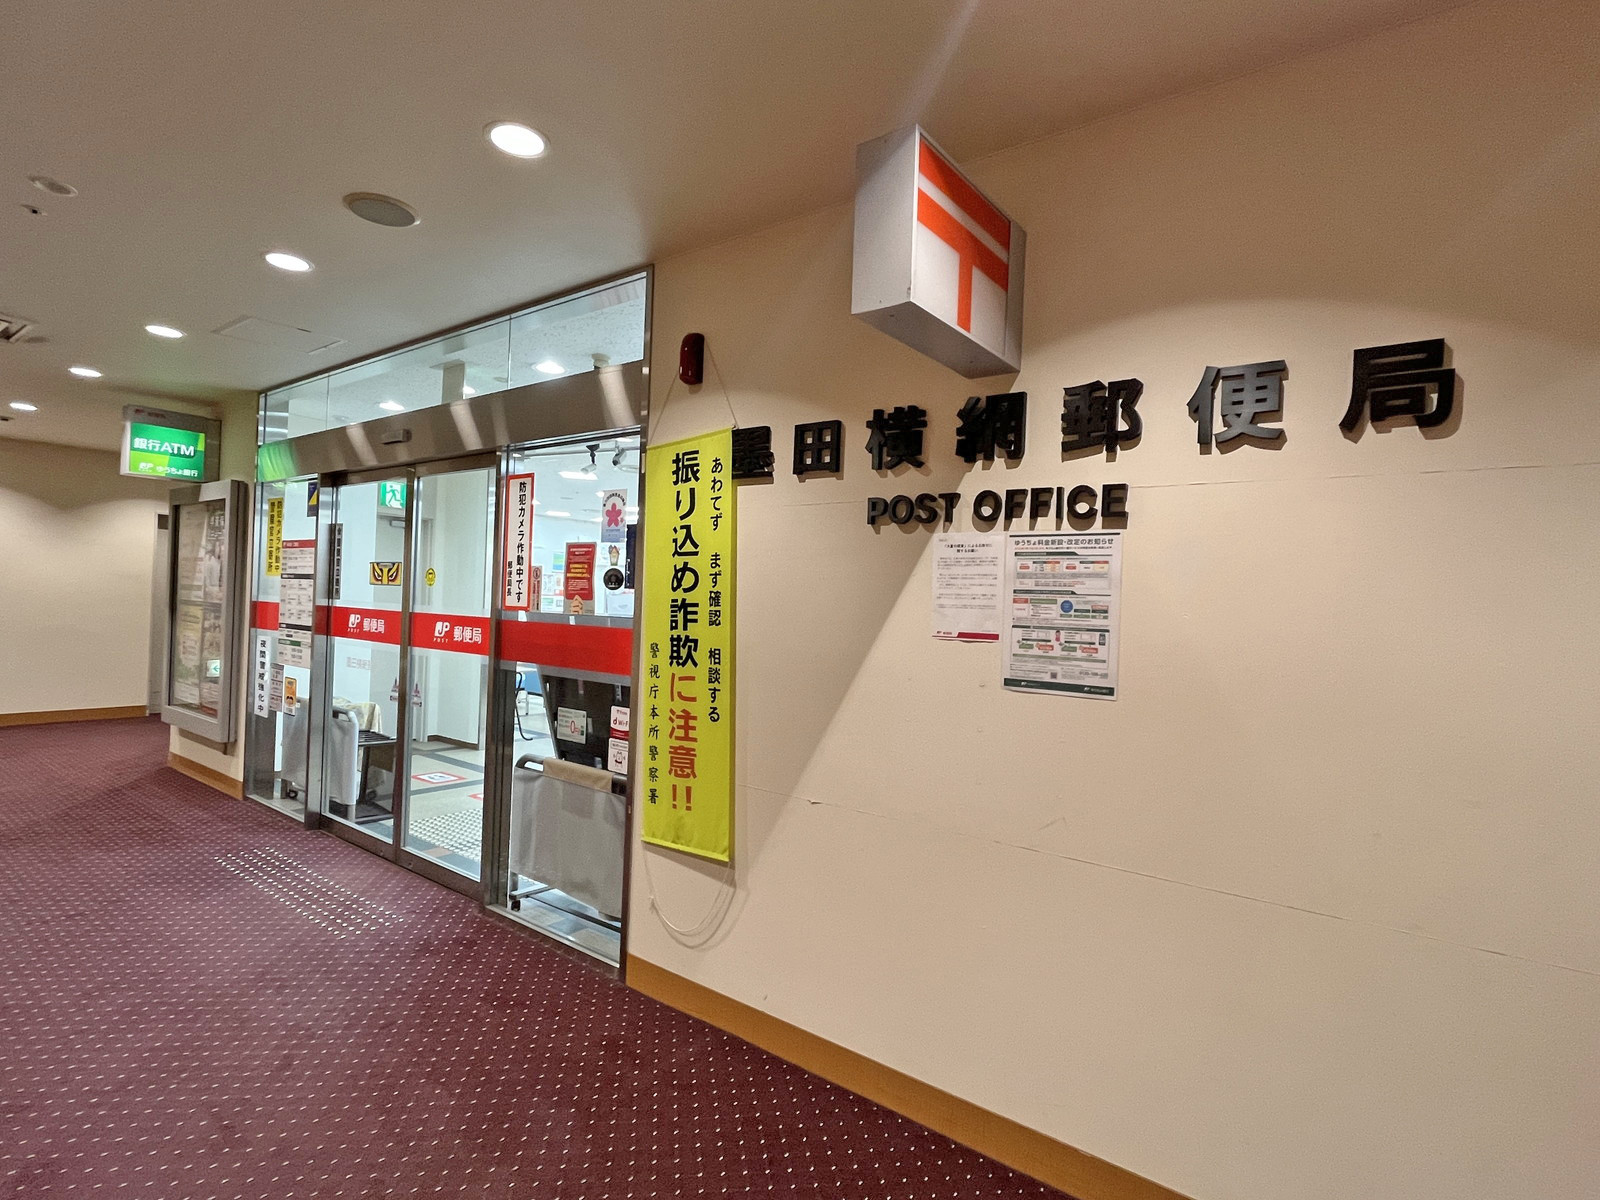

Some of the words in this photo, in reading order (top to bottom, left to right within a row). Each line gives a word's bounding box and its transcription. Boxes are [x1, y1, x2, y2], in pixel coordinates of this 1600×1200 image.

[134, 438, 195, 456] 銀行ATM
[156, 466, 199, 478] ゆうちょ銀行
[710, 457, 724, 531] あわてず
[866, 492, 962, 526] POST
[972, 483, 1130, 524] OFFICE
[515, 481, 527, 603] 防犯カメラ作動中です
[708, 552, 722, 627] まず確認
[363, 618, 385, 634] 郵便局
[434, 621, 450, 637] JP
[453, 626, 482, 644] 郵便局
[707, 648, 722, 723] 相談する
[648, 642, 661, 804] 警視庁本所警察署
